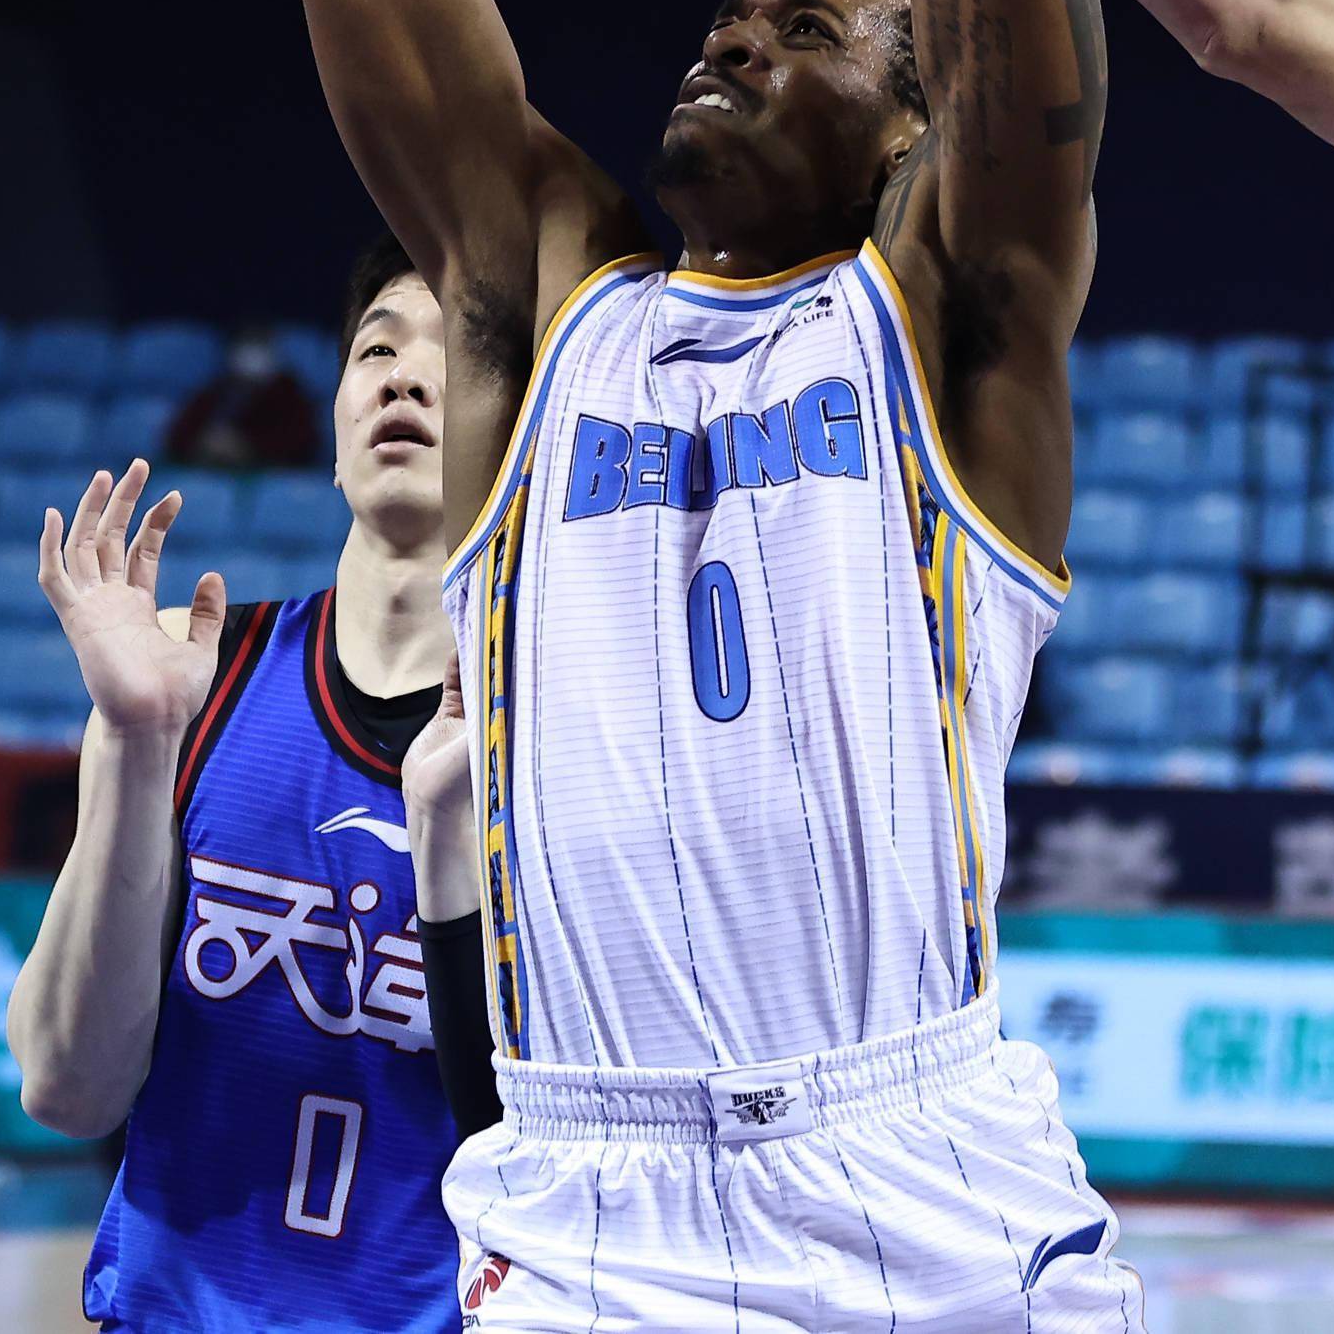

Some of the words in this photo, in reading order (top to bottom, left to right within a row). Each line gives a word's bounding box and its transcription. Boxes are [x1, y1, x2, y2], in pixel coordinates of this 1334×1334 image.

[804, 310, 834, 324] LIFE
[686, 560, 751, 723] 0
[283, 1092, 364, 1239] 0
